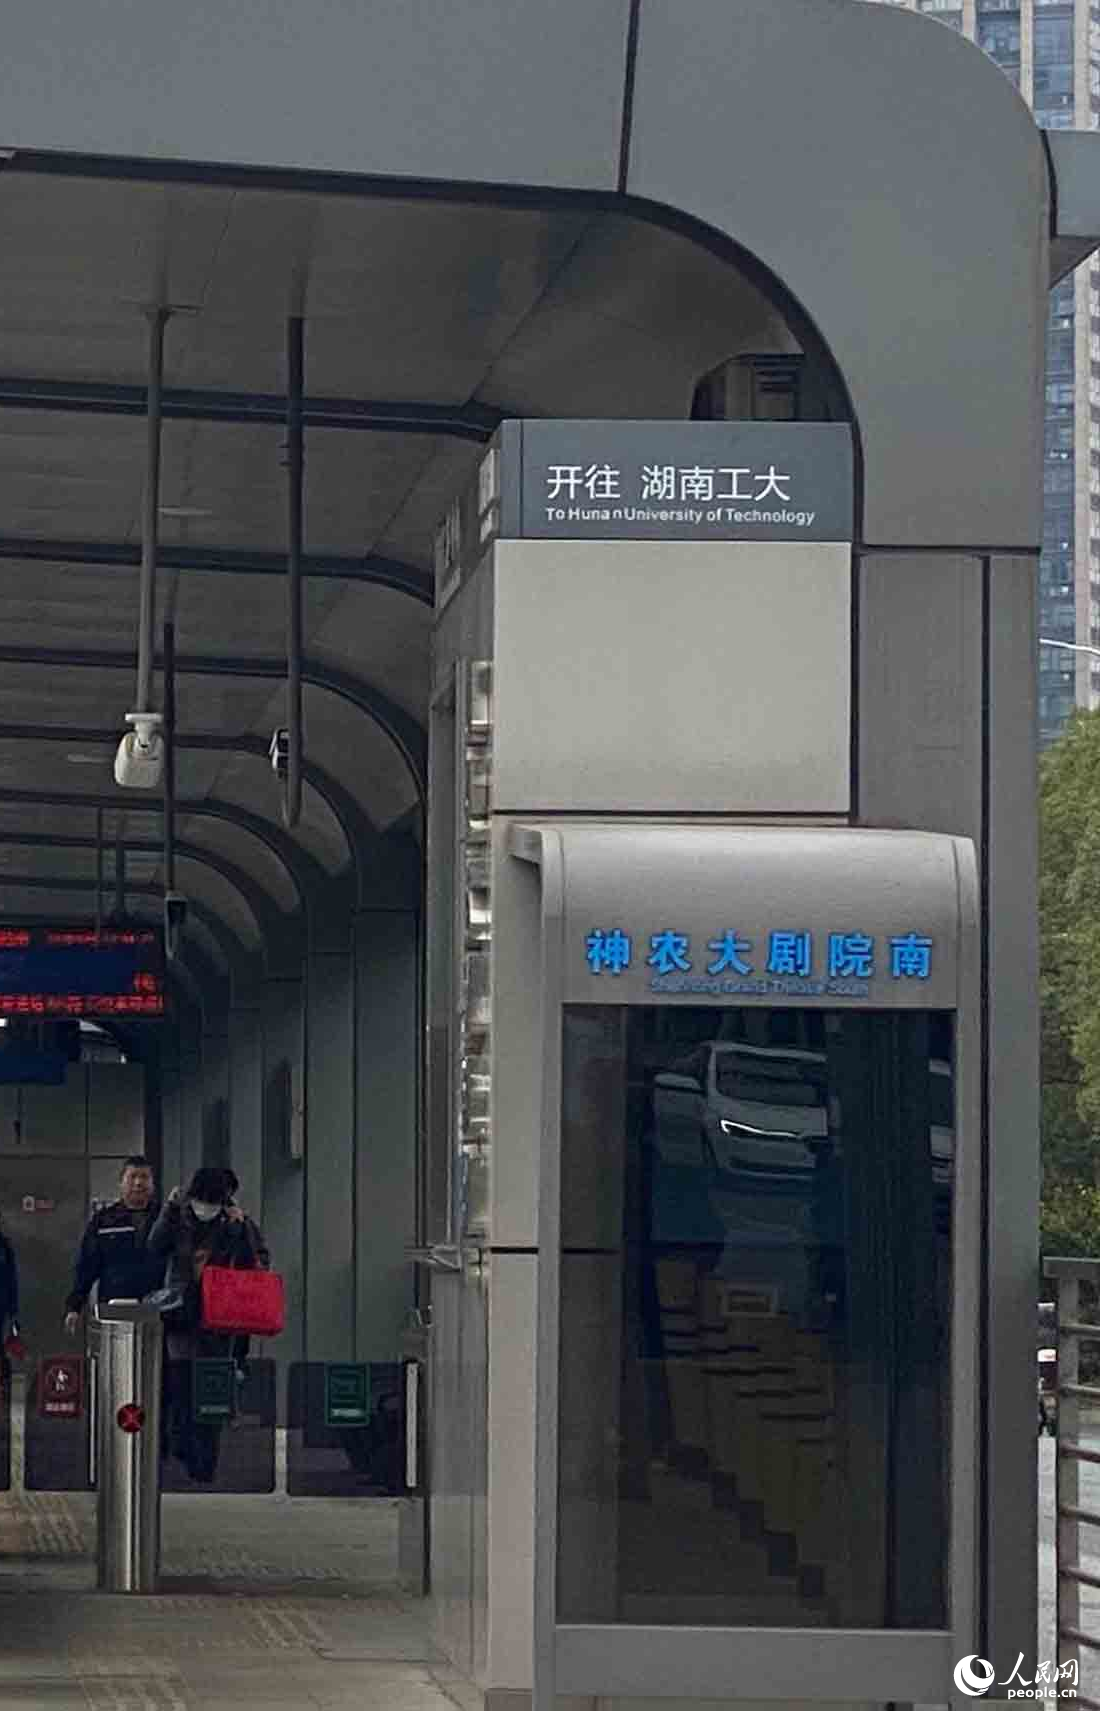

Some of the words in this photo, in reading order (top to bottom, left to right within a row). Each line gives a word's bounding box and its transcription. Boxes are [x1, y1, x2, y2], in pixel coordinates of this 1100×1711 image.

[547, 465, 621, 500] 开往
[641, 465, 791, 501] 湖南工大
[546, 508, 565, 521] To
[568, 508, 622, 521] Hunan
[623, 508, 702, 524] University
[706, 507, 722, 522] of
[725, 508, 815, 526] Technology
[587, 929, 933, 977] 神农大剧院南
